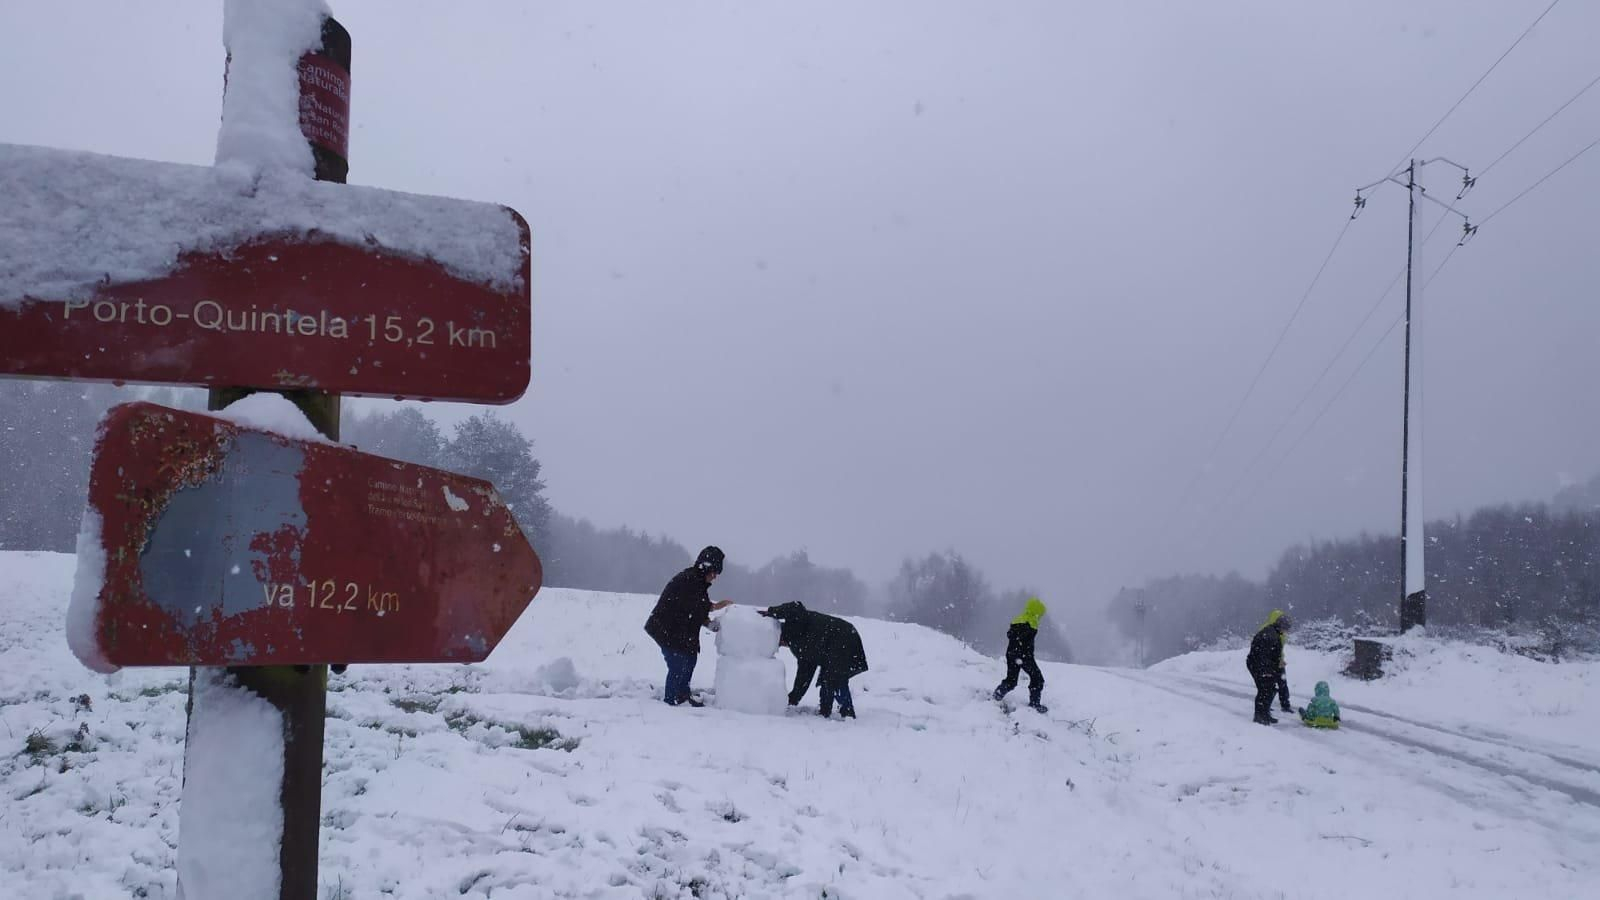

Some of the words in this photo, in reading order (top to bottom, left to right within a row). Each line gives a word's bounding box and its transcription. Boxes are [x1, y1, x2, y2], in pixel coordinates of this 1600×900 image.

[63, 297, 349, 339] Porto-Quintela
[363, 313, 434, 347] 15,2
[448, 319, 497, 349] km
[306, 579, 359, 614] 12,2
[367, 583, 401, 613] km
